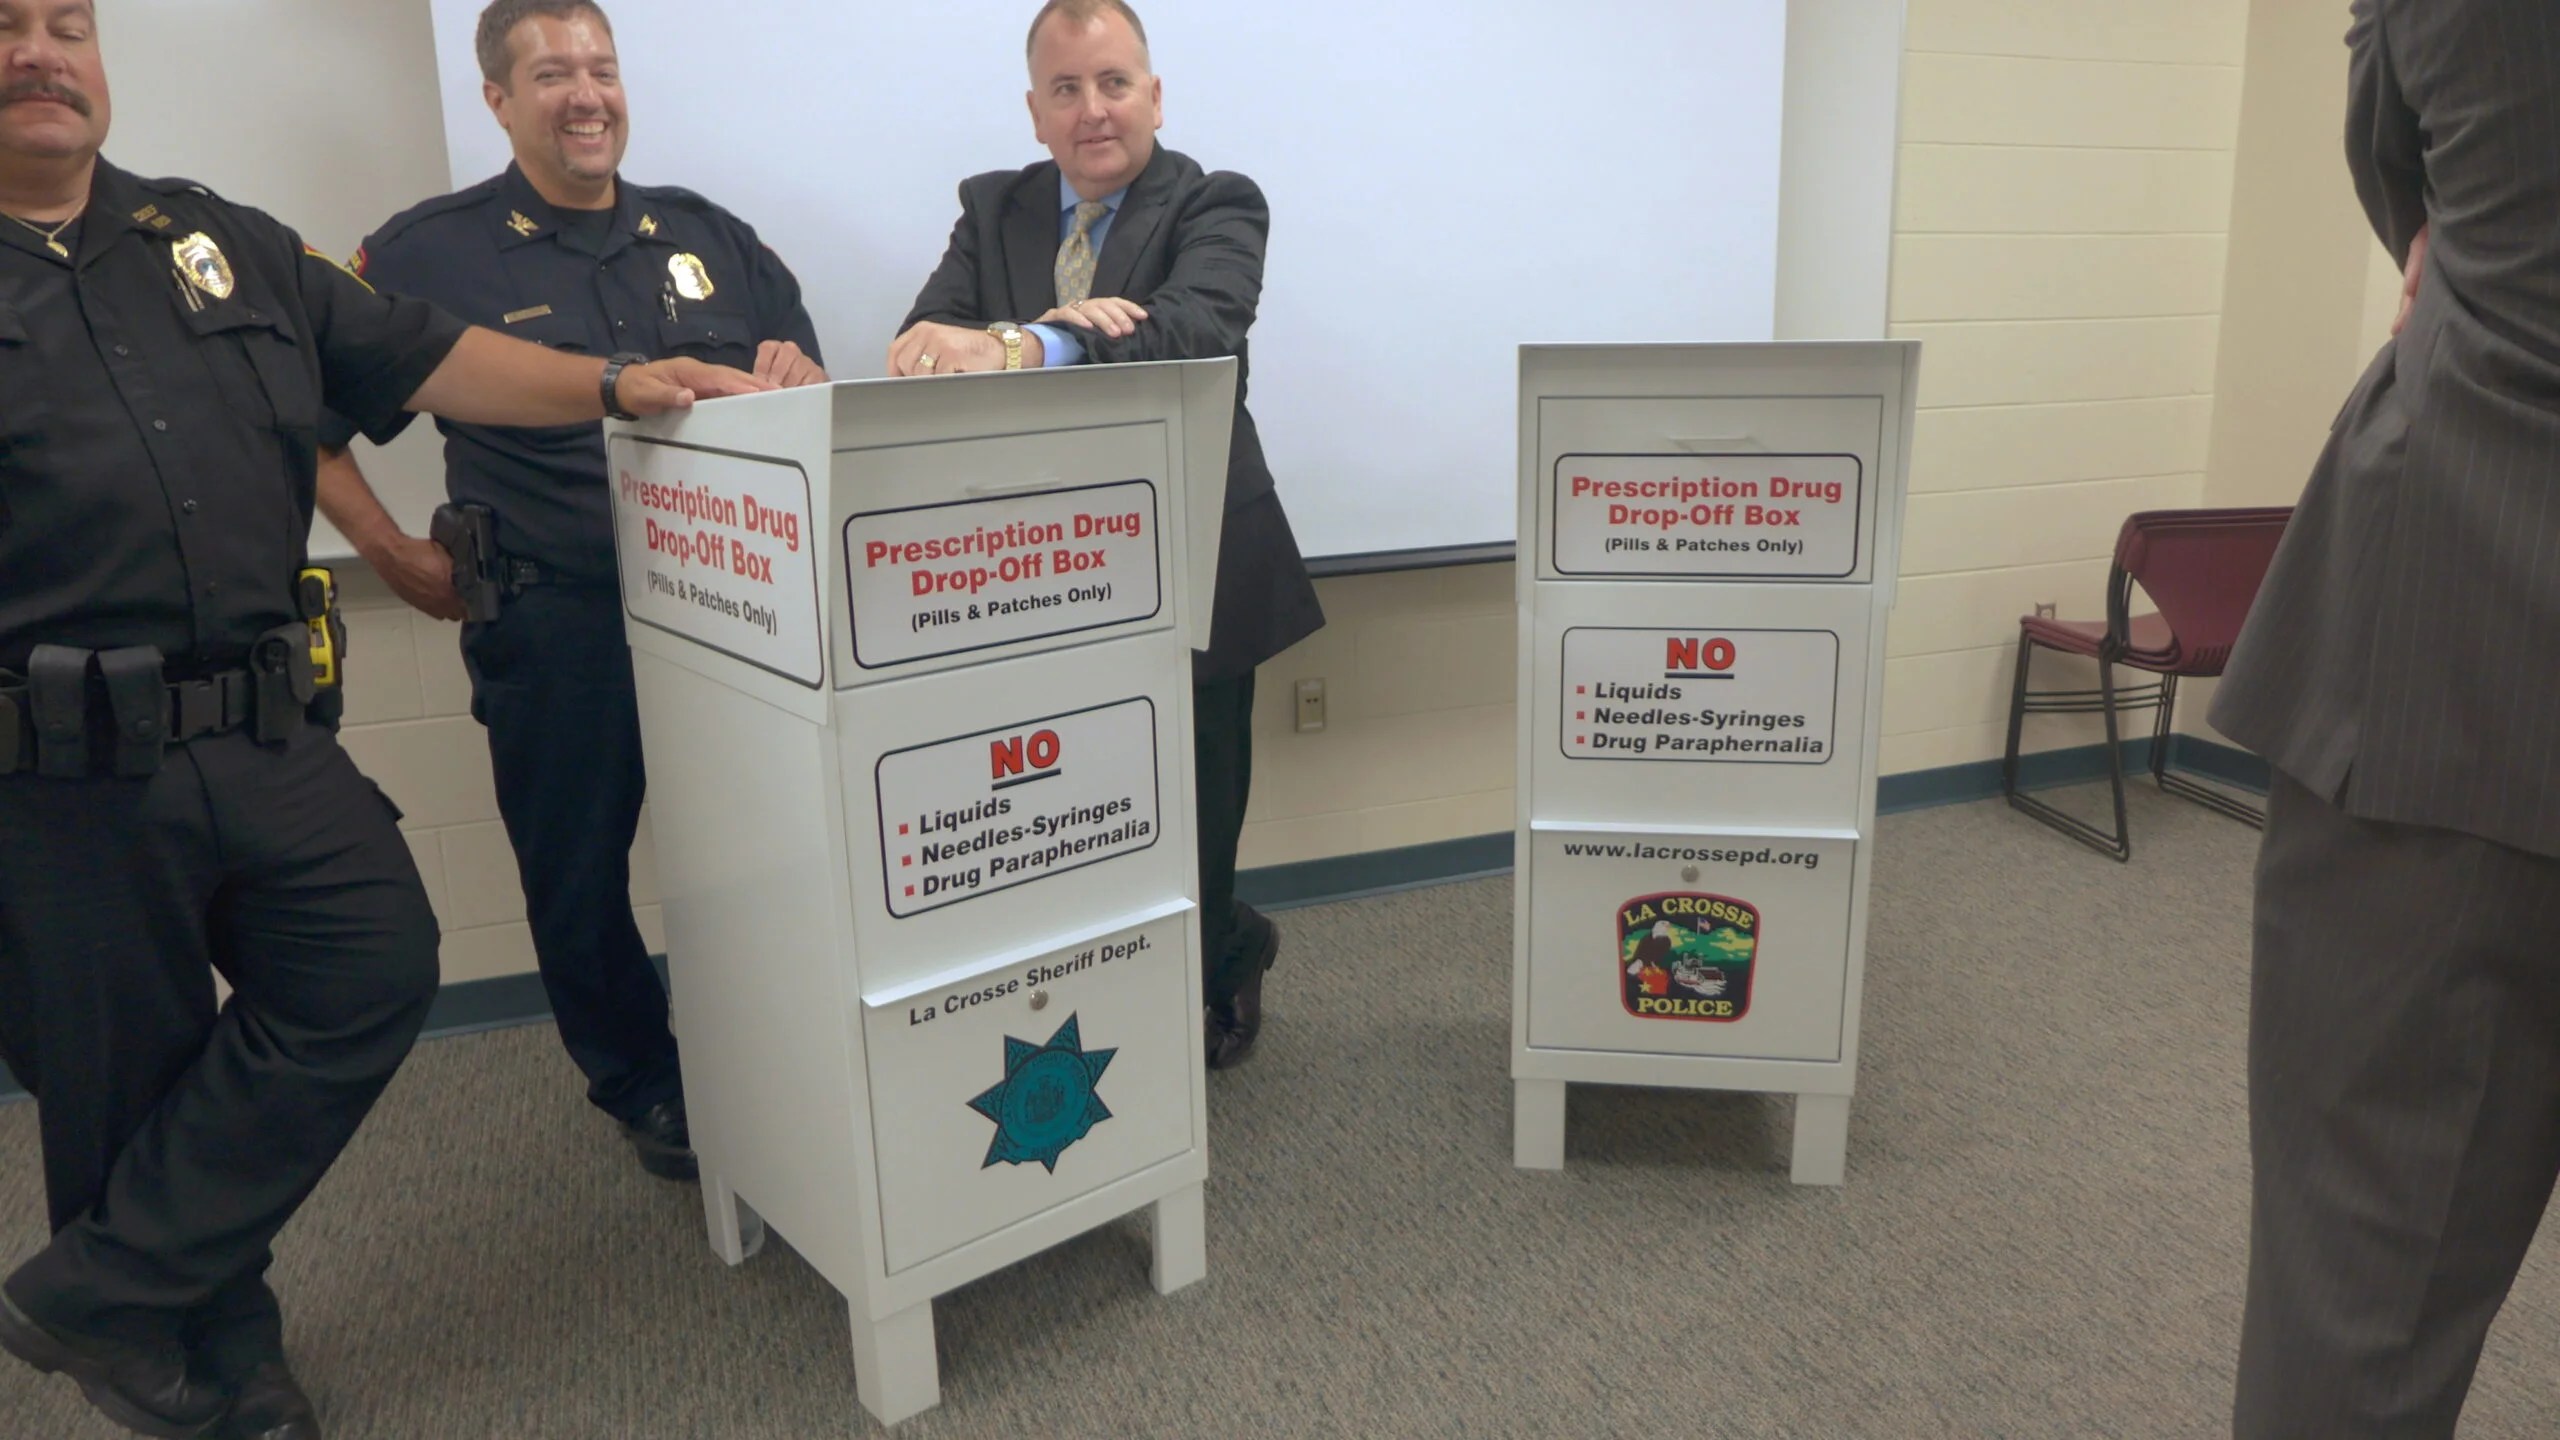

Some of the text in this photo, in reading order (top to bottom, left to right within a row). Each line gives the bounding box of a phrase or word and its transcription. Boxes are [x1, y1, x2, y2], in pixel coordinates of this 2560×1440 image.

[1571, 476, 1842, 503] Prescription Drug
[620, 470, 799, 552] Prescription Drug
[1608, 504, 1801, 530] Drop-Off Box
[646, 518, 774, 585] Drop-Off Box
[866, 512, 1141, 568] Prescription Drug
[1604, 537, 1804, 555] (Pills & Patches Only)
[911, 549, 1106, 596] Drop-Off Box
[647, 570, 777, 636] (Pills & Patches Only)
[911, 582, 1112, 633] (Pills & Patches Only)
[1666, 637, 1736, 671] NO
[1594, 682, 1682, 703] Liquids
[1593, 707, 1805, 730] Needles-Syringes
[990, 728, 1061, 780] NO
[1592, 732, 1824, 755] Drug Paraphernalia
[919, 795, 1011, 836] Liquids
[921, 795, 1132, 866] Needles-Syringes
[922, 818, 1151, 897] Drug Paraphernalia
[1564, 842, 1819, 869] www.lacrossepd.org
[1623, 897, 1754, 929] LA CROSSE
[909, 932, 1152, 1027] La Crosse Sheriff Dept.
[1637, 997, 1733, 1017] POLICE
